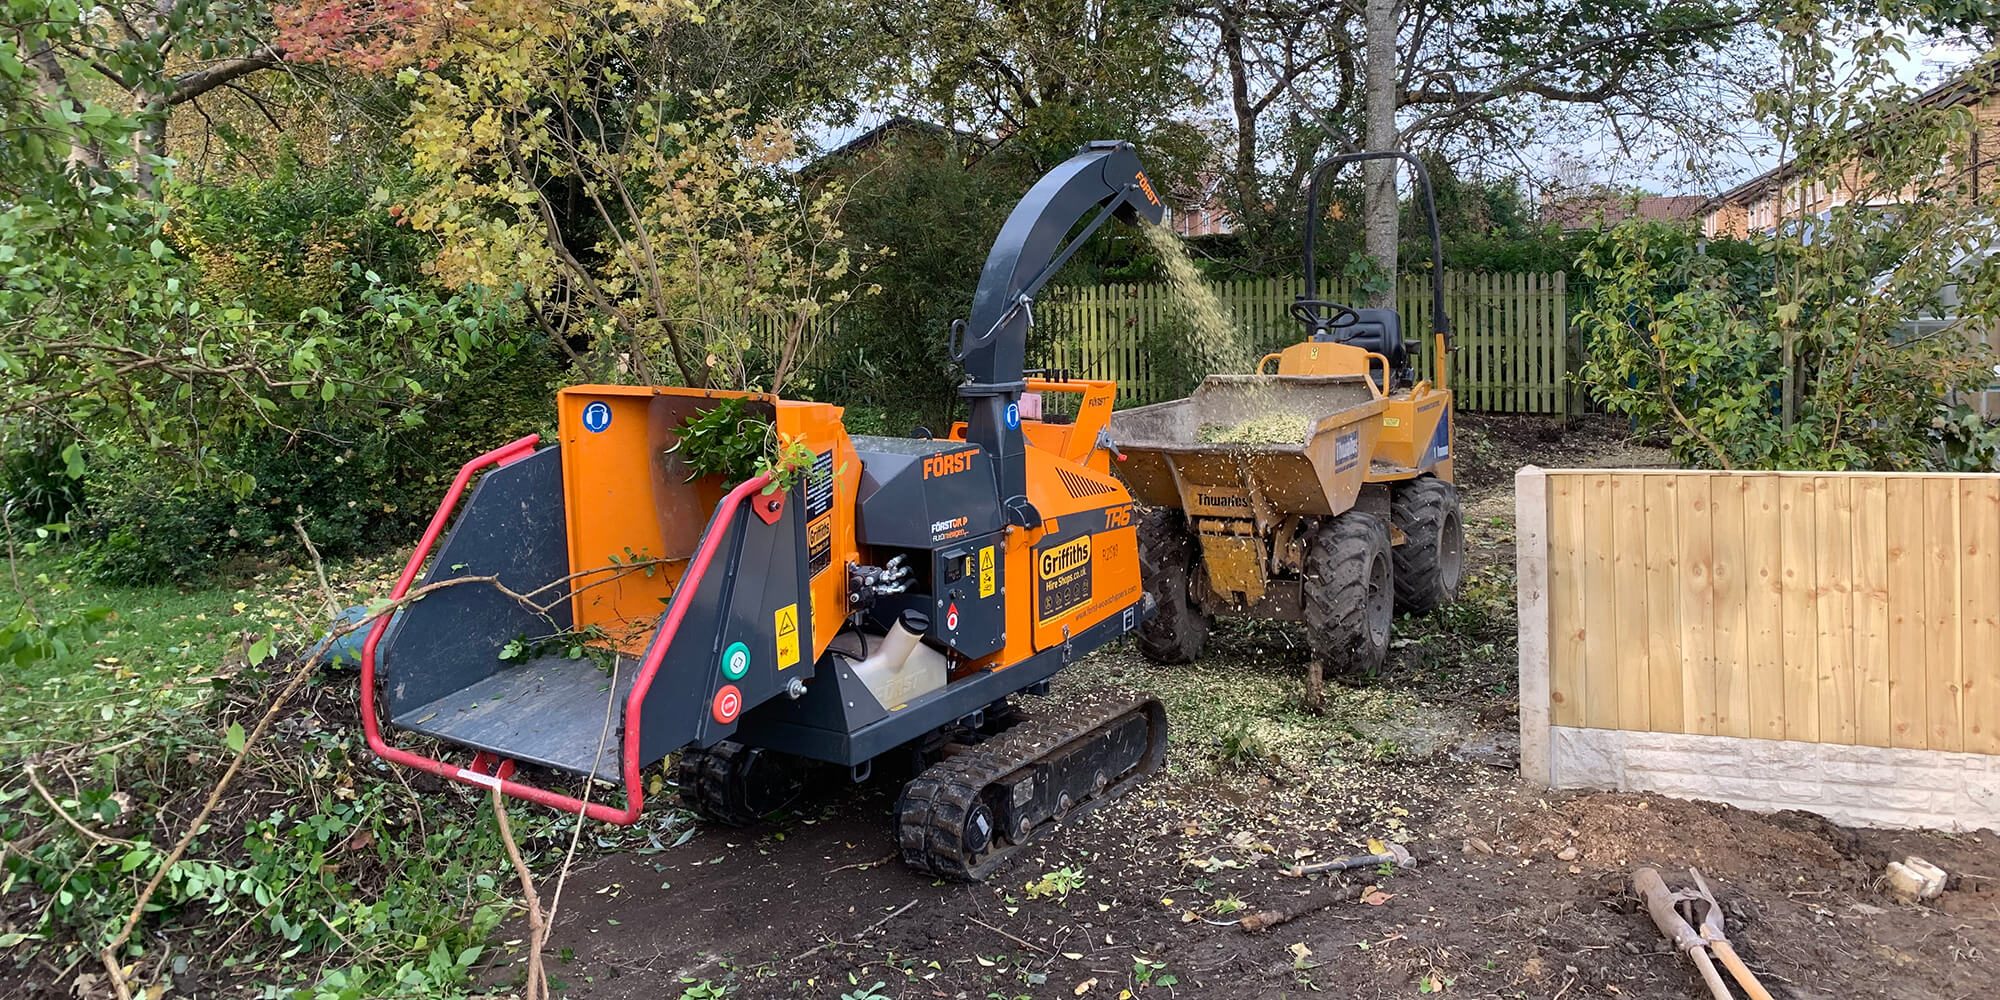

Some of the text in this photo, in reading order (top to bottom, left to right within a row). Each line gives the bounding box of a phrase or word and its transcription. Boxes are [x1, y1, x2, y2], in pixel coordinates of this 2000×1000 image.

[1135, 170, 1161, 207] FÖRST
[923, 448, 980, 480] FÖRST
[1197, 493, 1249, 508] Thwaites
[1104, 504, 1133, 529] TR6
[1043, 542, 1089, 576] Griffiths
[1045, 579, 1059, 592] Hire
